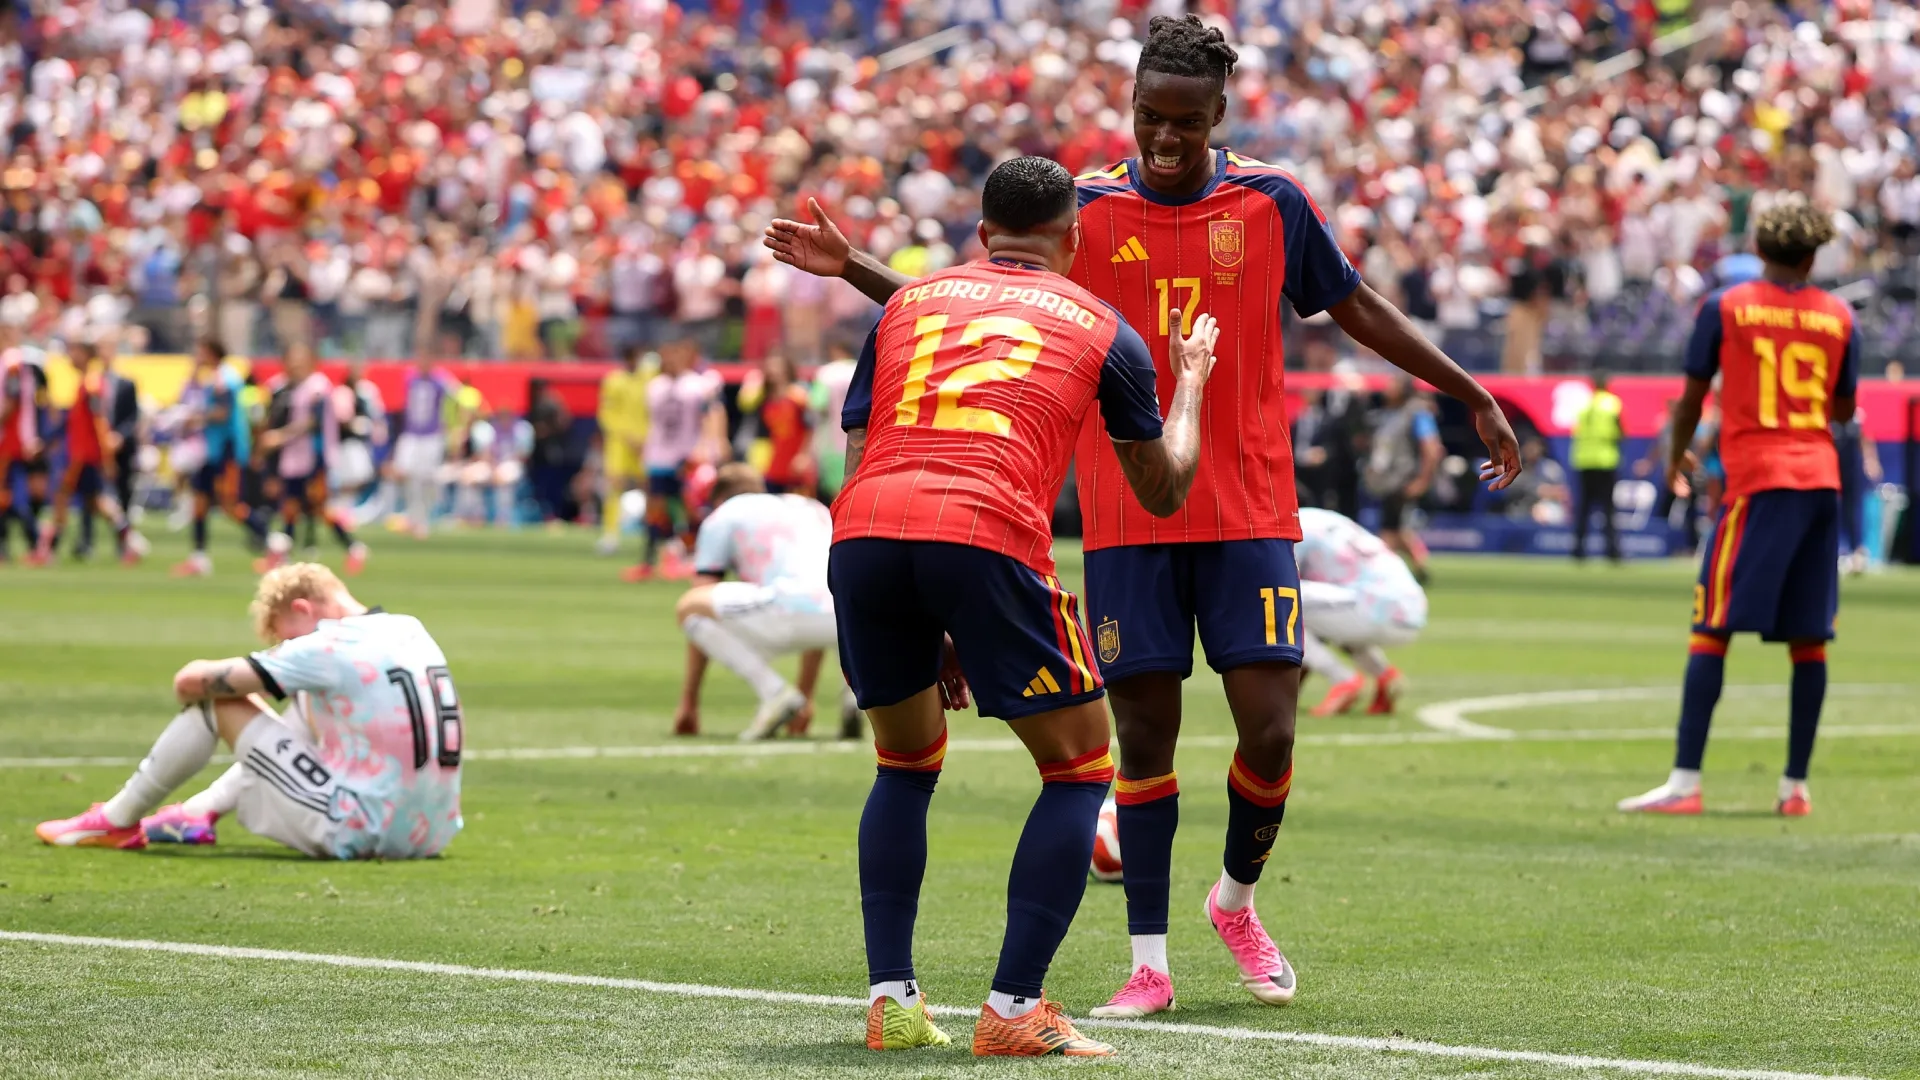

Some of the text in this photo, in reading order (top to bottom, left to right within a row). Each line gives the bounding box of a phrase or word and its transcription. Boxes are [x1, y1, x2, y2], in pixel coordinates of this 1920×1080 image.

[900, 279, 1097, 330] PEDRO PORRO
[1155, 277, 1201, 336] 17
[894, 314, 1045, 438] 12
[1753, 336, 1828, 430] 19
[1260, 586, 1299, 646] 17
[386, 666, 462, 769] 18
